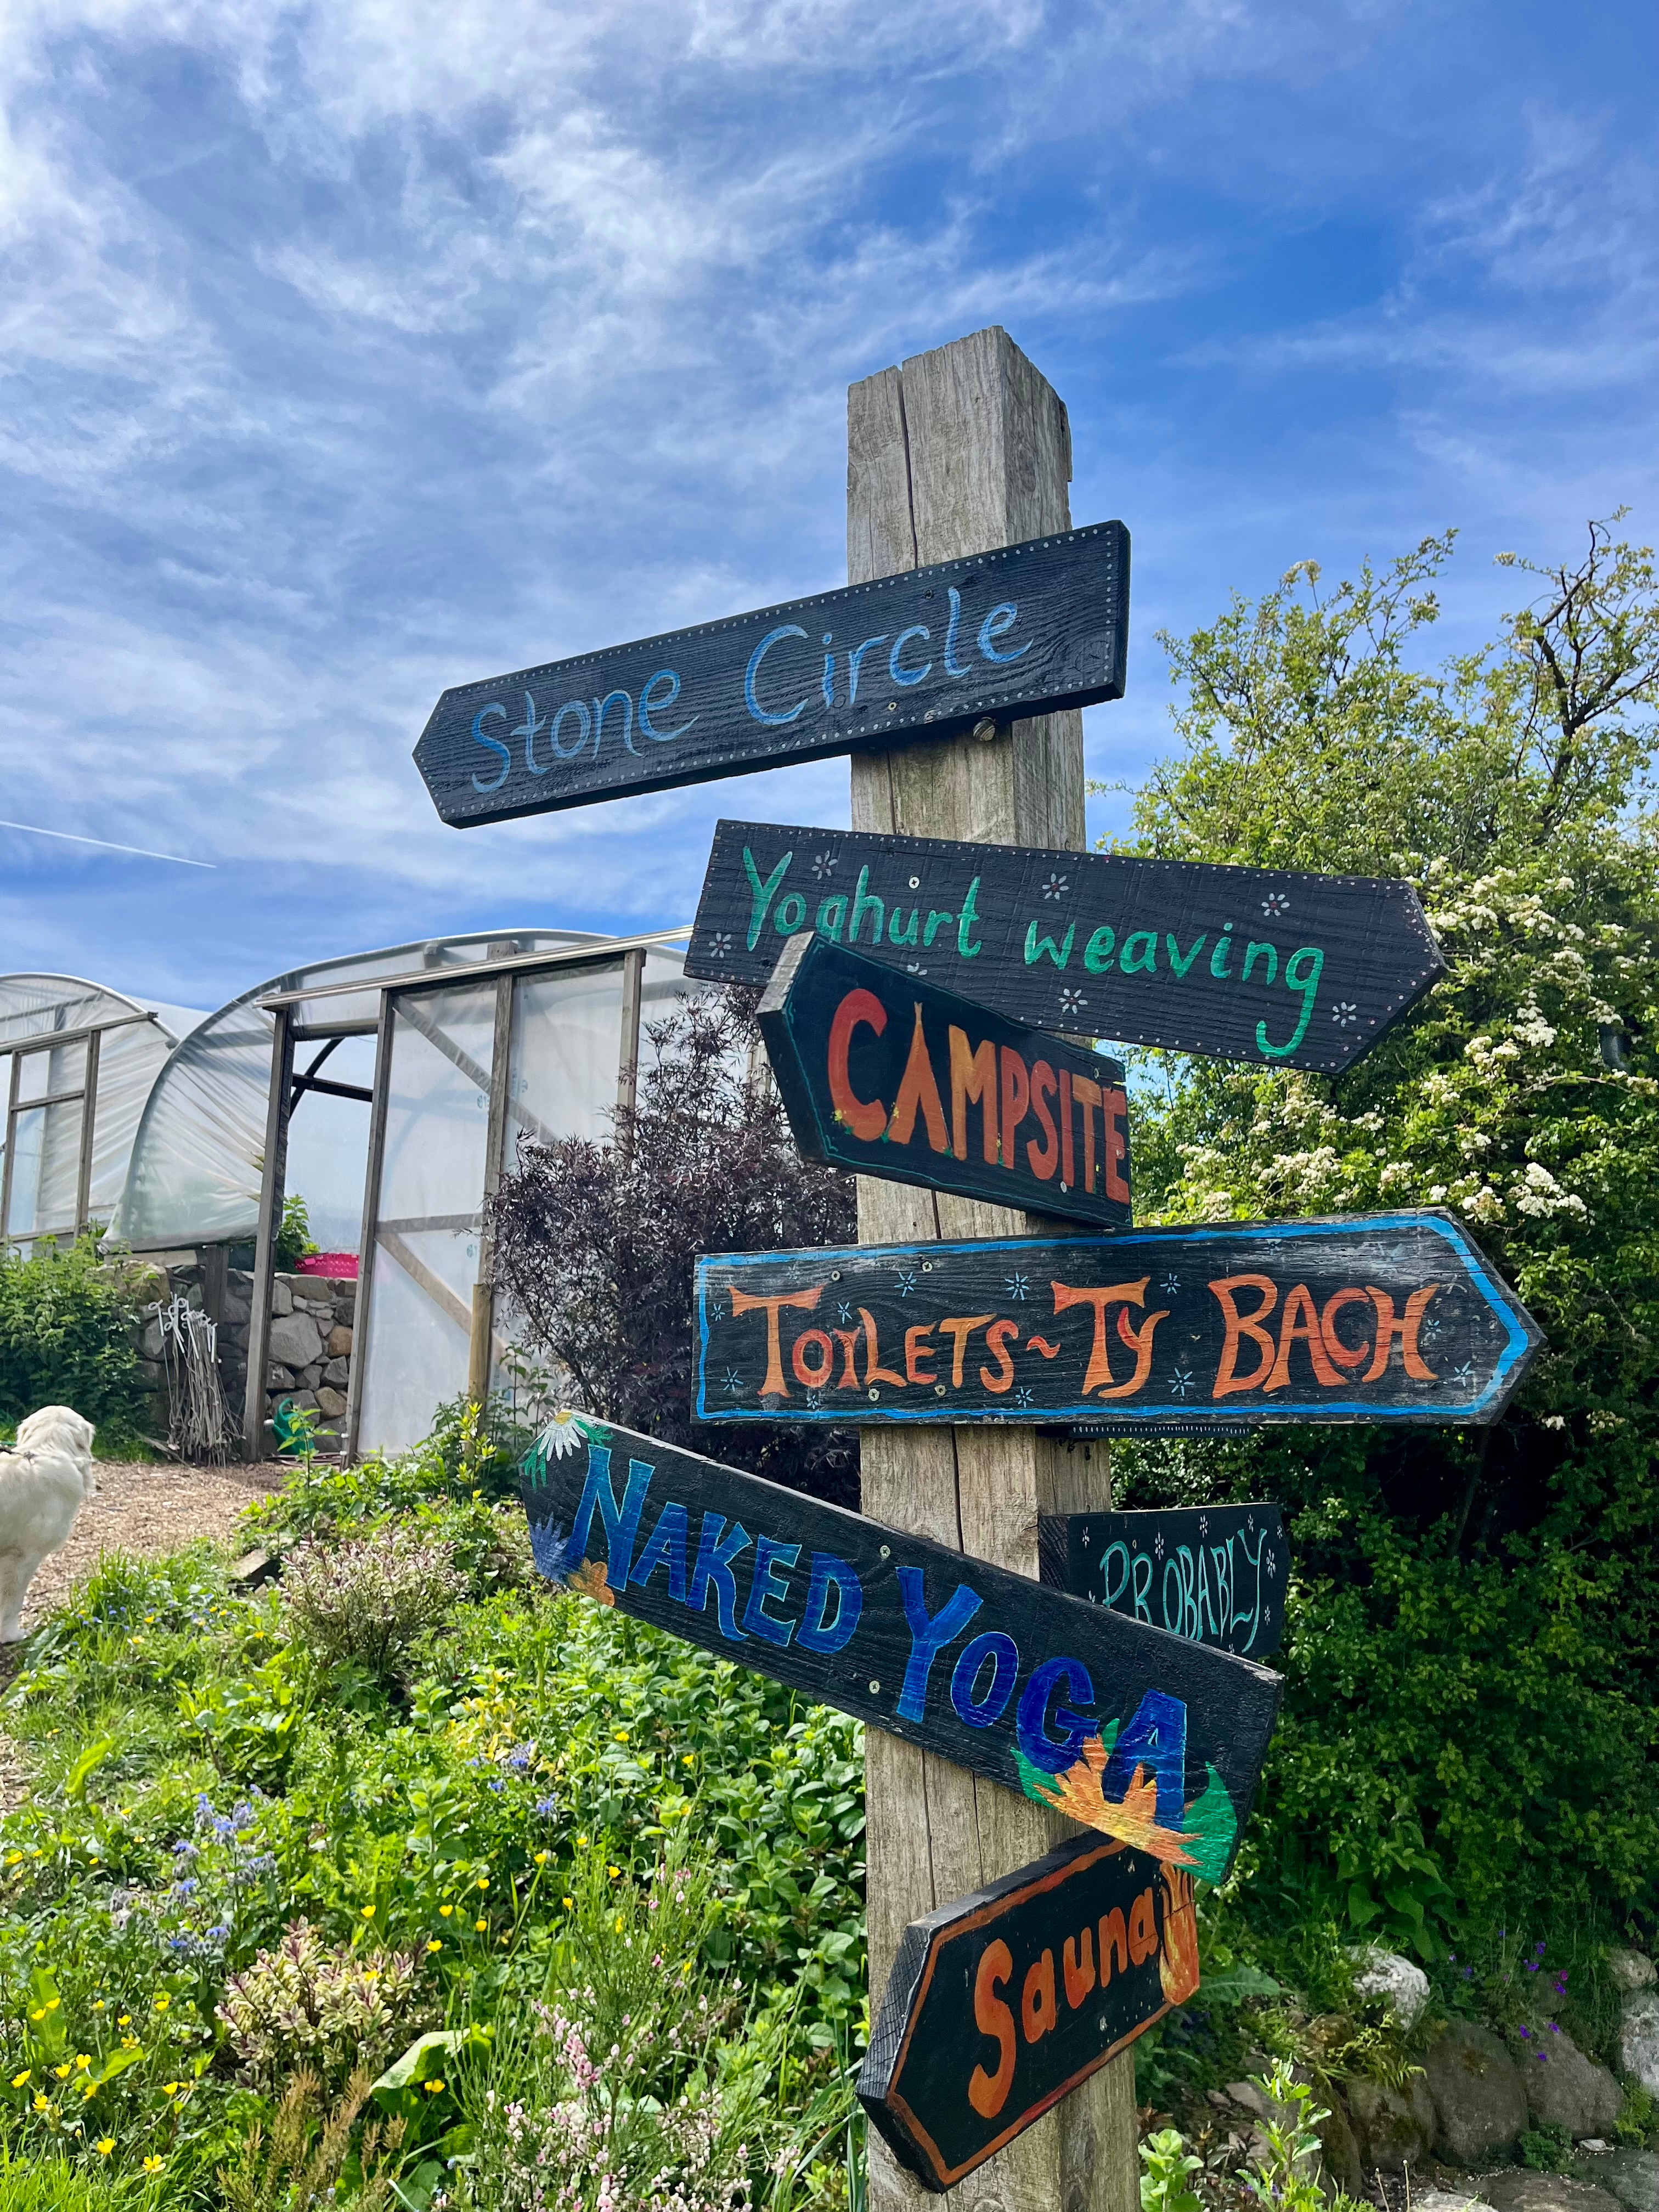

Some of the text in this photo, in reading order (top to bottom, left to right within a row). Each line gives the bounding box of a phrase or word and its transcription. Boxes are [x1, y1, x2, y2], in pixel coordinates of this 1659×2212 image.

[472, 587, 1035, 793] Stone Circle
[1024, 919, 1324, 1057] weaving
[828, 989, 1130, 1205] CAMPSITE
[1208, 1273, 1440, 1399] BACH
[563, 1444, 1188, 1833] NAKED YOGA
[1099, 1527, 1267, 1654] PROBABLY
[968, 1886, 1159, 2119] Sauna
